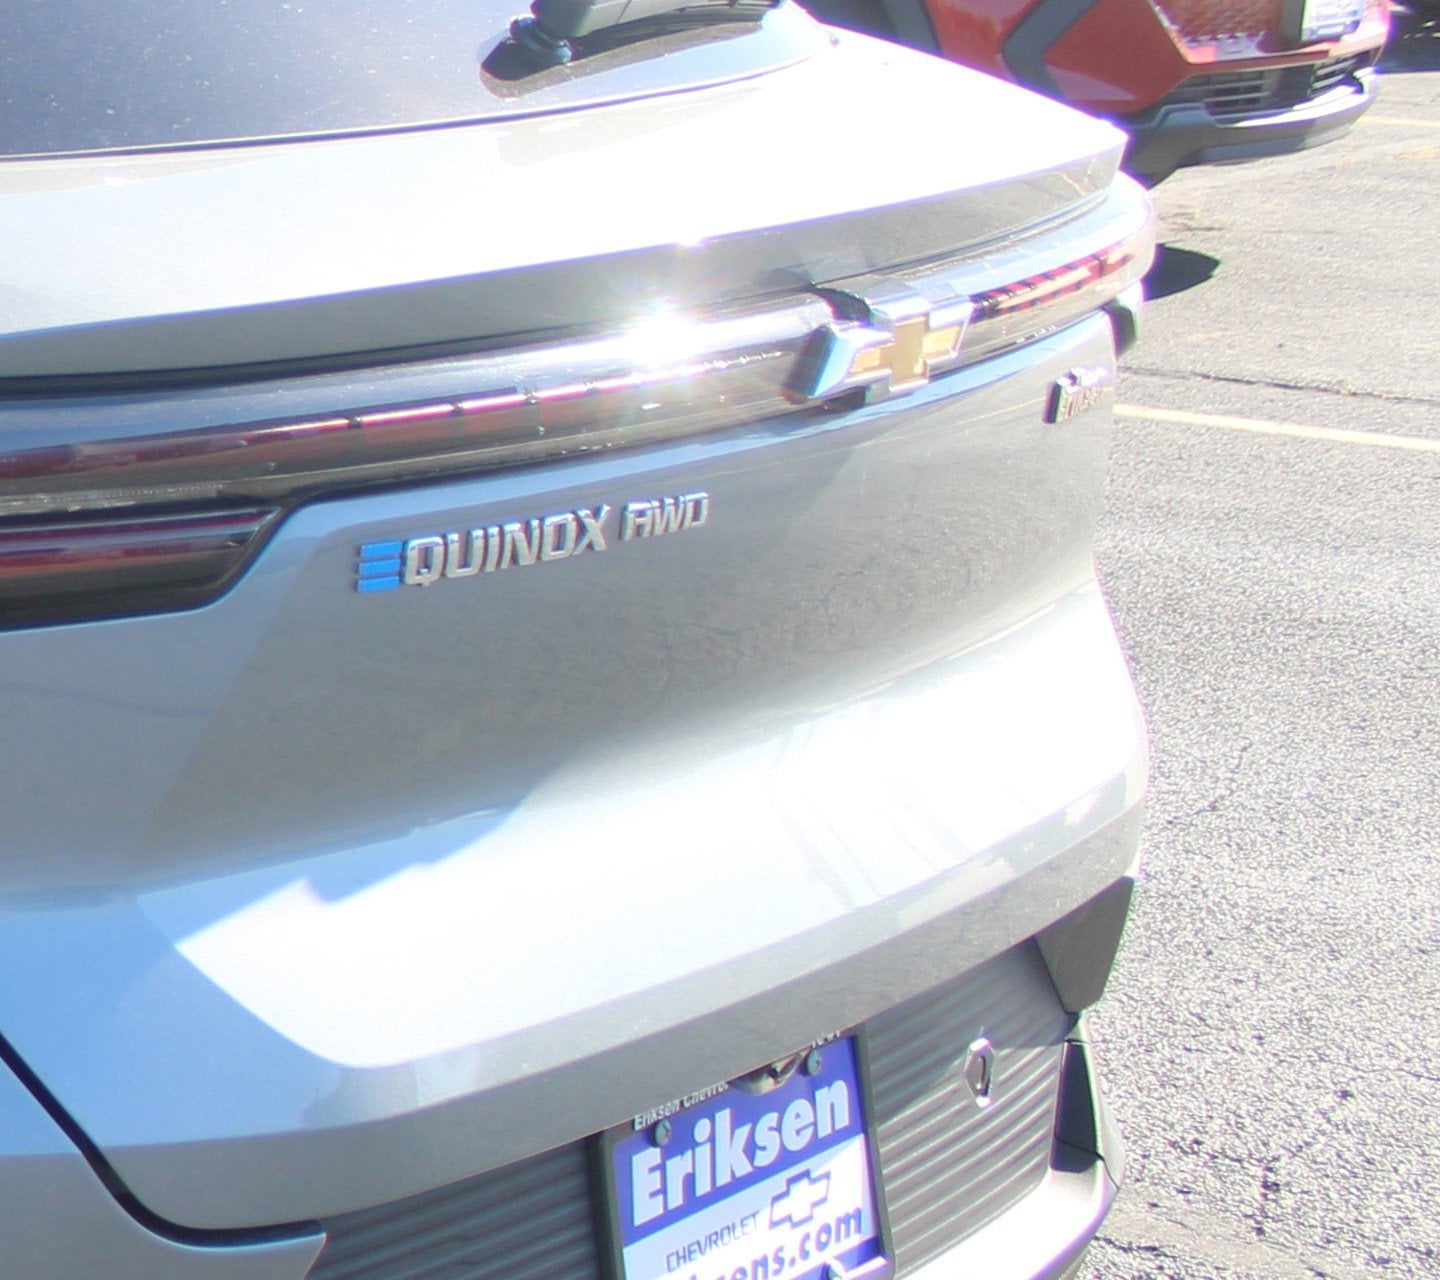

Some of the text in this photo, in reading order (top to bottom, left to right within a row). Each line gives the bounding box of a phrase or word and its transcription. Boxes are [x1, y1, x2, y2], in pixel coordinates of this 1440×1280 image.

[357, 491, 709, 593] EQUINOX AWD
[631, 1078, 851, 1227] Eriksen
[665, 1209, 760, 1273] CHEVROLET
